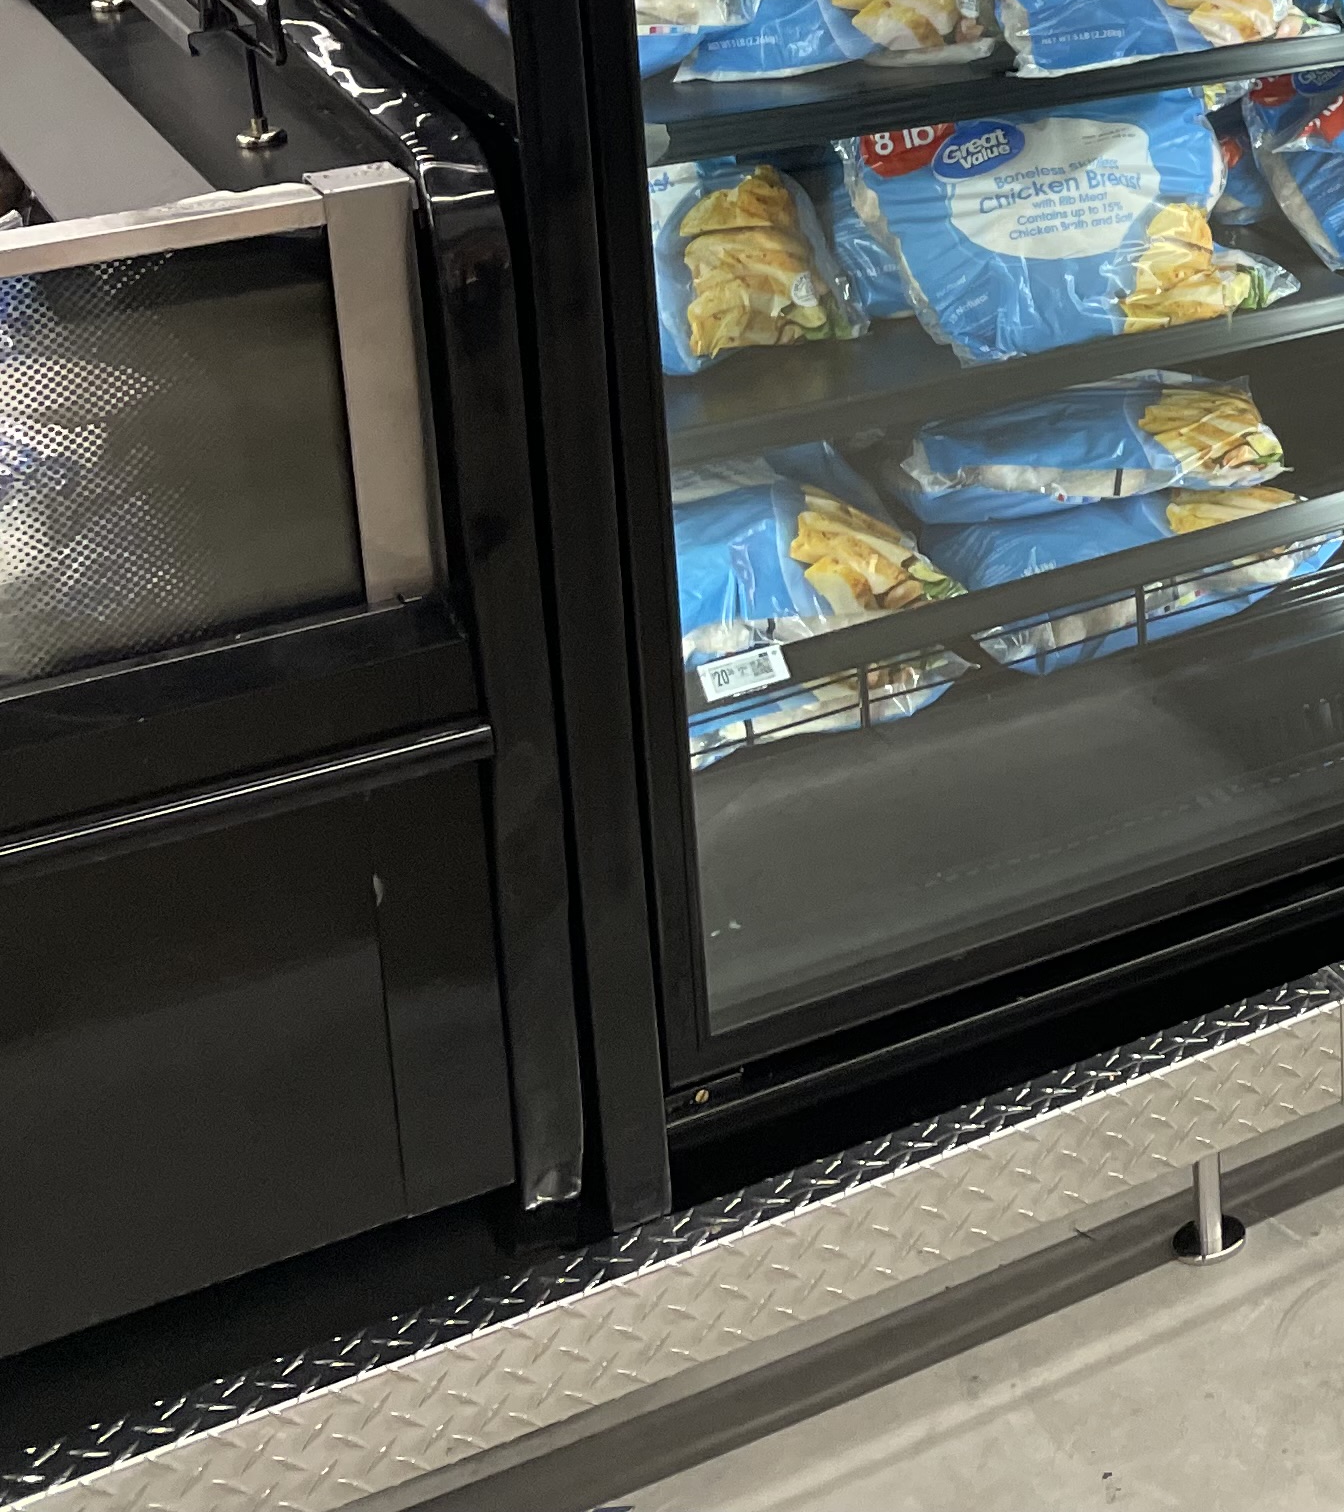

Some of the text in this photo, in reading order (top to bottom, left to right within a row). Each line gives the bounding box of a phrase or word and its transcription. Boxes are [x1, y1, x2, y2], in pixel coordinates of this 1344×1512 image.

[873, 123, 935, 156] 8 lb
[942, 128, 1011, 165] Great
[959, 144, 1011, 170] Value
[993, 165, 1066, 190] Boneless
[979, 168, 1142, 215] Chicken Breast
[1031, 196, 1056, 209] with
[1078, 191, 1108, 204] Meat
[1017, 208, 1068, 226] Contains
[1070, 207, 1087, 220] up
[1087, 204, 1099, 215] to
[1009, 222, 1059, 241] Chicken
[1091, 216, 1113, 228] and
